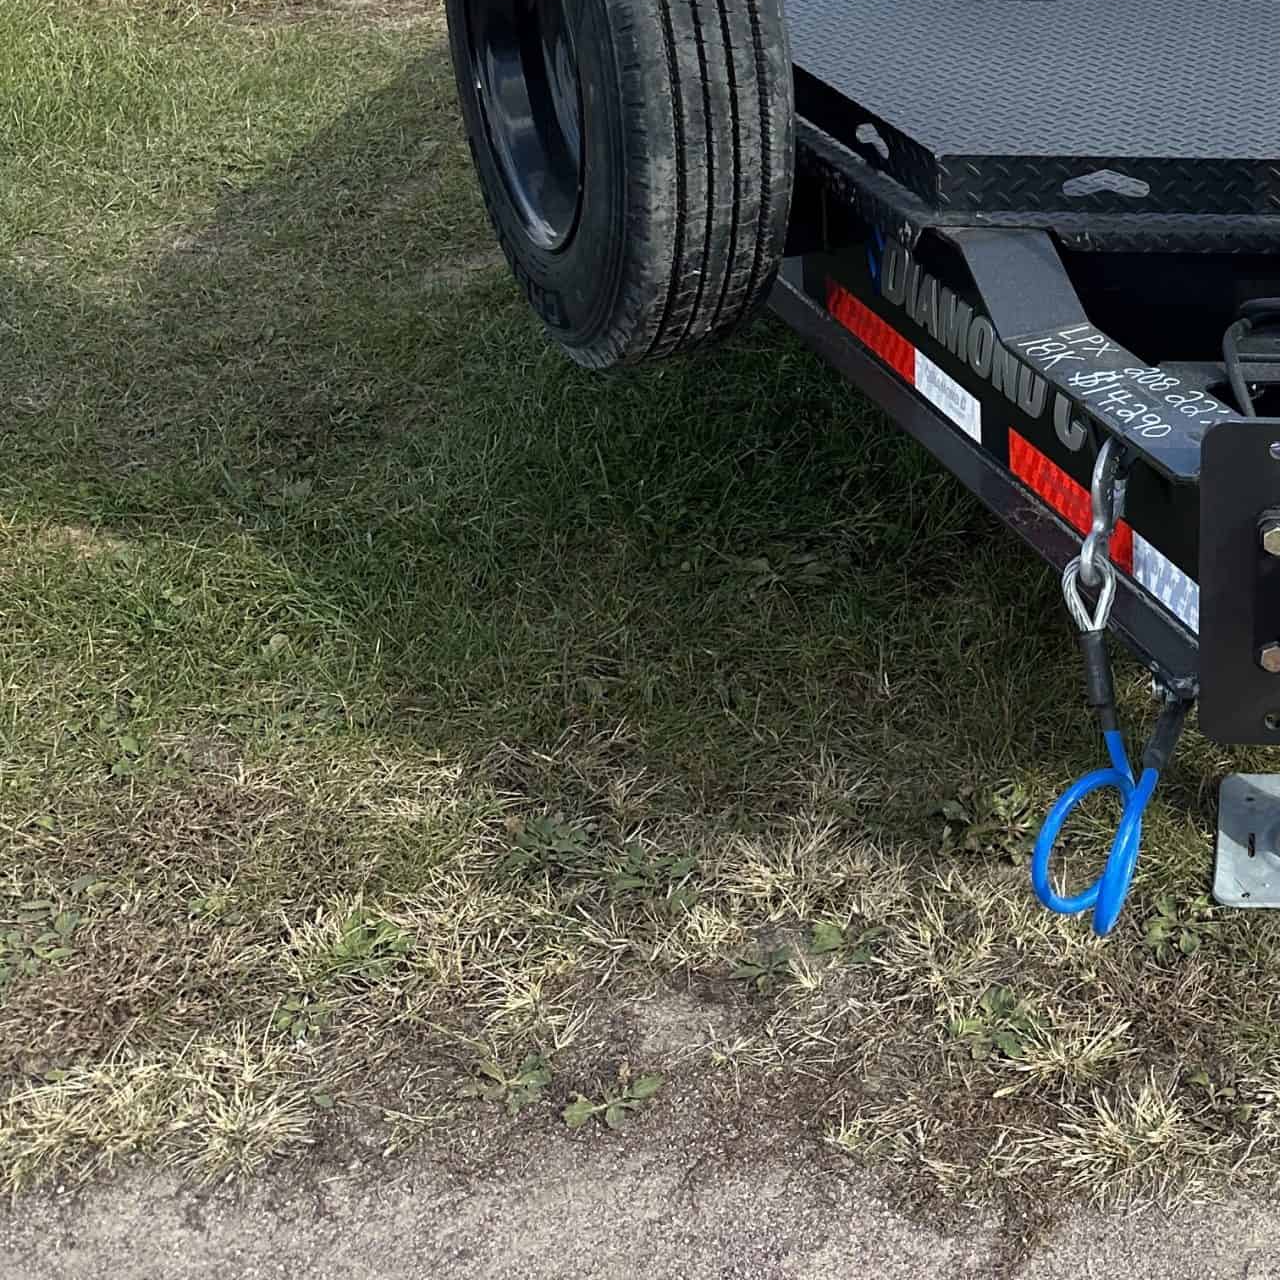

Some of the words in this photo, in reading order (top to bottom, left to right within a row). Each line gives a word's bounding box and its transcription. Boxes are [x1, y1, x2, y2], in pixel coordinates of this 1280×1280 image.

[881, 240, 1048, 419] DIAMOND
[1053, 391, 1088, 452] C
[1017, 337, 1086, 371] 18K
[1058, 325, 1120, 357] LPX
